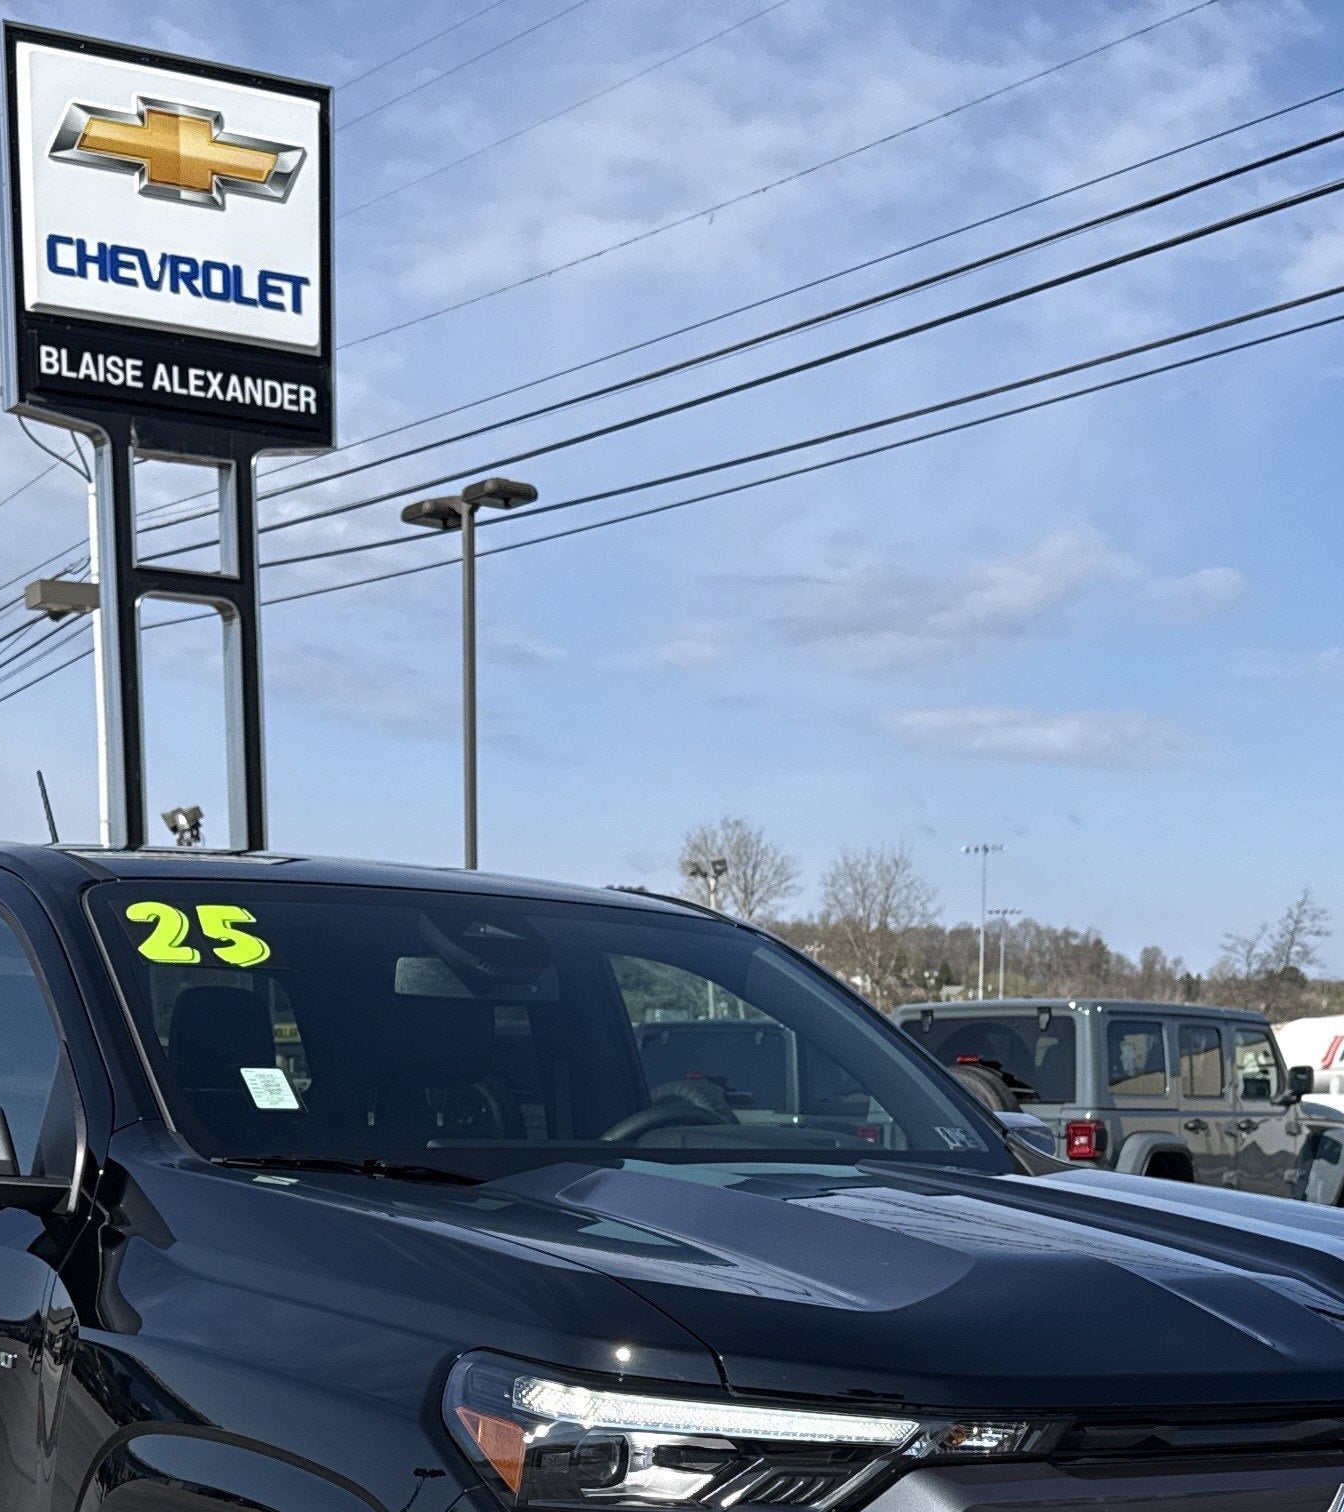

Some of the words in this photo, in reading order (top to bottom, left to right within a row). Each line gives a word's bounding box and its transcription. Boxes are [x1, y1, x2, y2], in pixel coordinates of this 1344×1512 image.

[46, 233, 311, 315] CHEVROLET
[39, 345, 144, 389] BLAISE
[152, 363, 318, 415] ALEXANDER
[125, 901, 271, 968] 25
